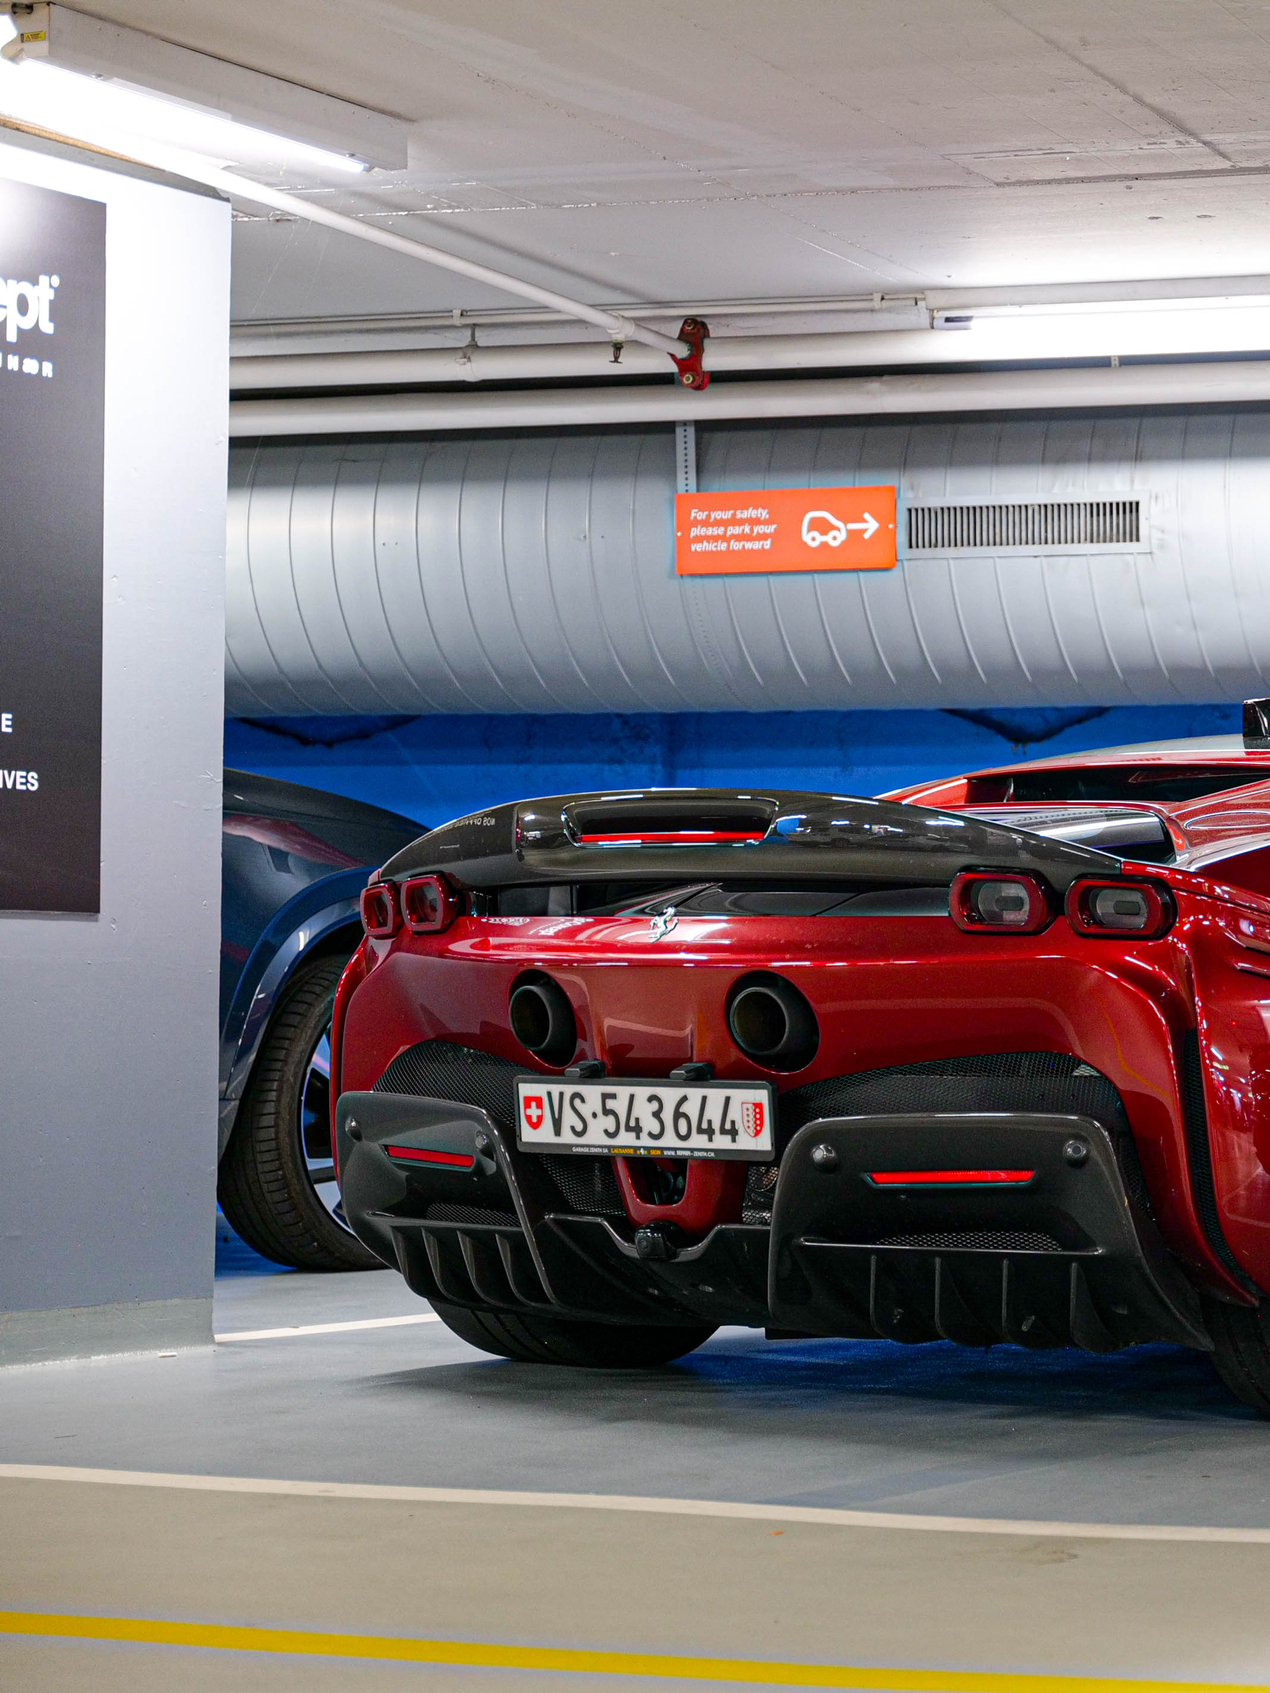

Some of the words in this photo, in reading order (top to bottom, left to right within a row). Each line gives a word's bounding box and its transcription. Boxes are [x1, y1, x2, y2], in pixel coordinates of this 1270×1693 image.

[691, 509, 709, 520] For
[710, 510, 734, 522] your
[736, 507, 769, 520] safety,
[690, 525, 725, 538] please
[726, 523, 751, 537] park
[752, 524, 778, 537] your
[691, 540, 728, 551] vehicle
[730, 538, 771, 549] forward
